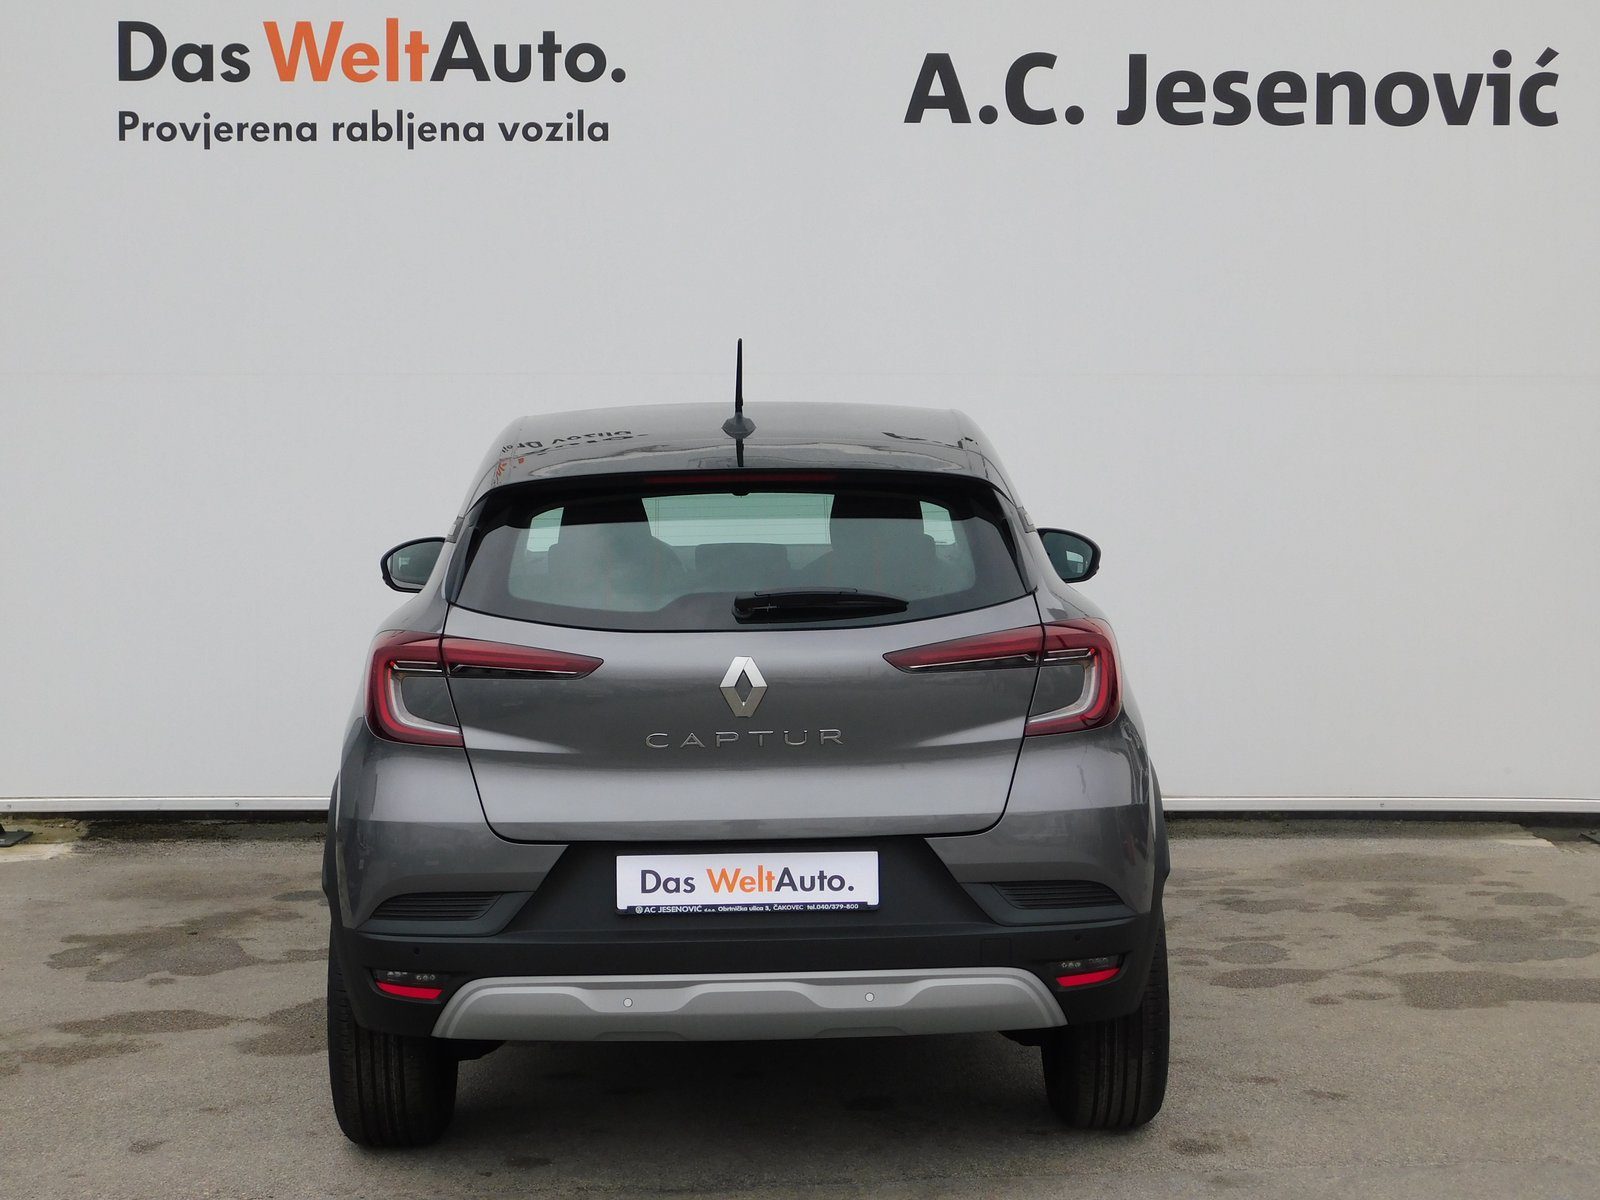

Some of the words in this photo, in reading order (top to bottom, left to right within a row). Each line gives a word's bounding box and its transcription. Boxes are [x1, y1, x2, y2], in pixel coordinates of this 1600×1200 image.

[118, 21, 250, 83] Das
[263, 18, 626, 83] WeltAuto.
[904, 52, 1084, 125] A.C.
[1117, 47, 1559, 127] Jesenović
[118, 111, 317, 150] Provjerena
[333, 110, 485, 150] rabljena
[498, 109, 609, 142] vozila
[645, 728, 844, 748] CAPTUR
[640, 869, 696, 894] Das
[706, 865, 855, 893] WeltAuto.
[643, 906, 656, 914] AC
[658, 904, 702, 913] JESENOVIĆ
[773, 903, 804, 911] ČAKOVEC
